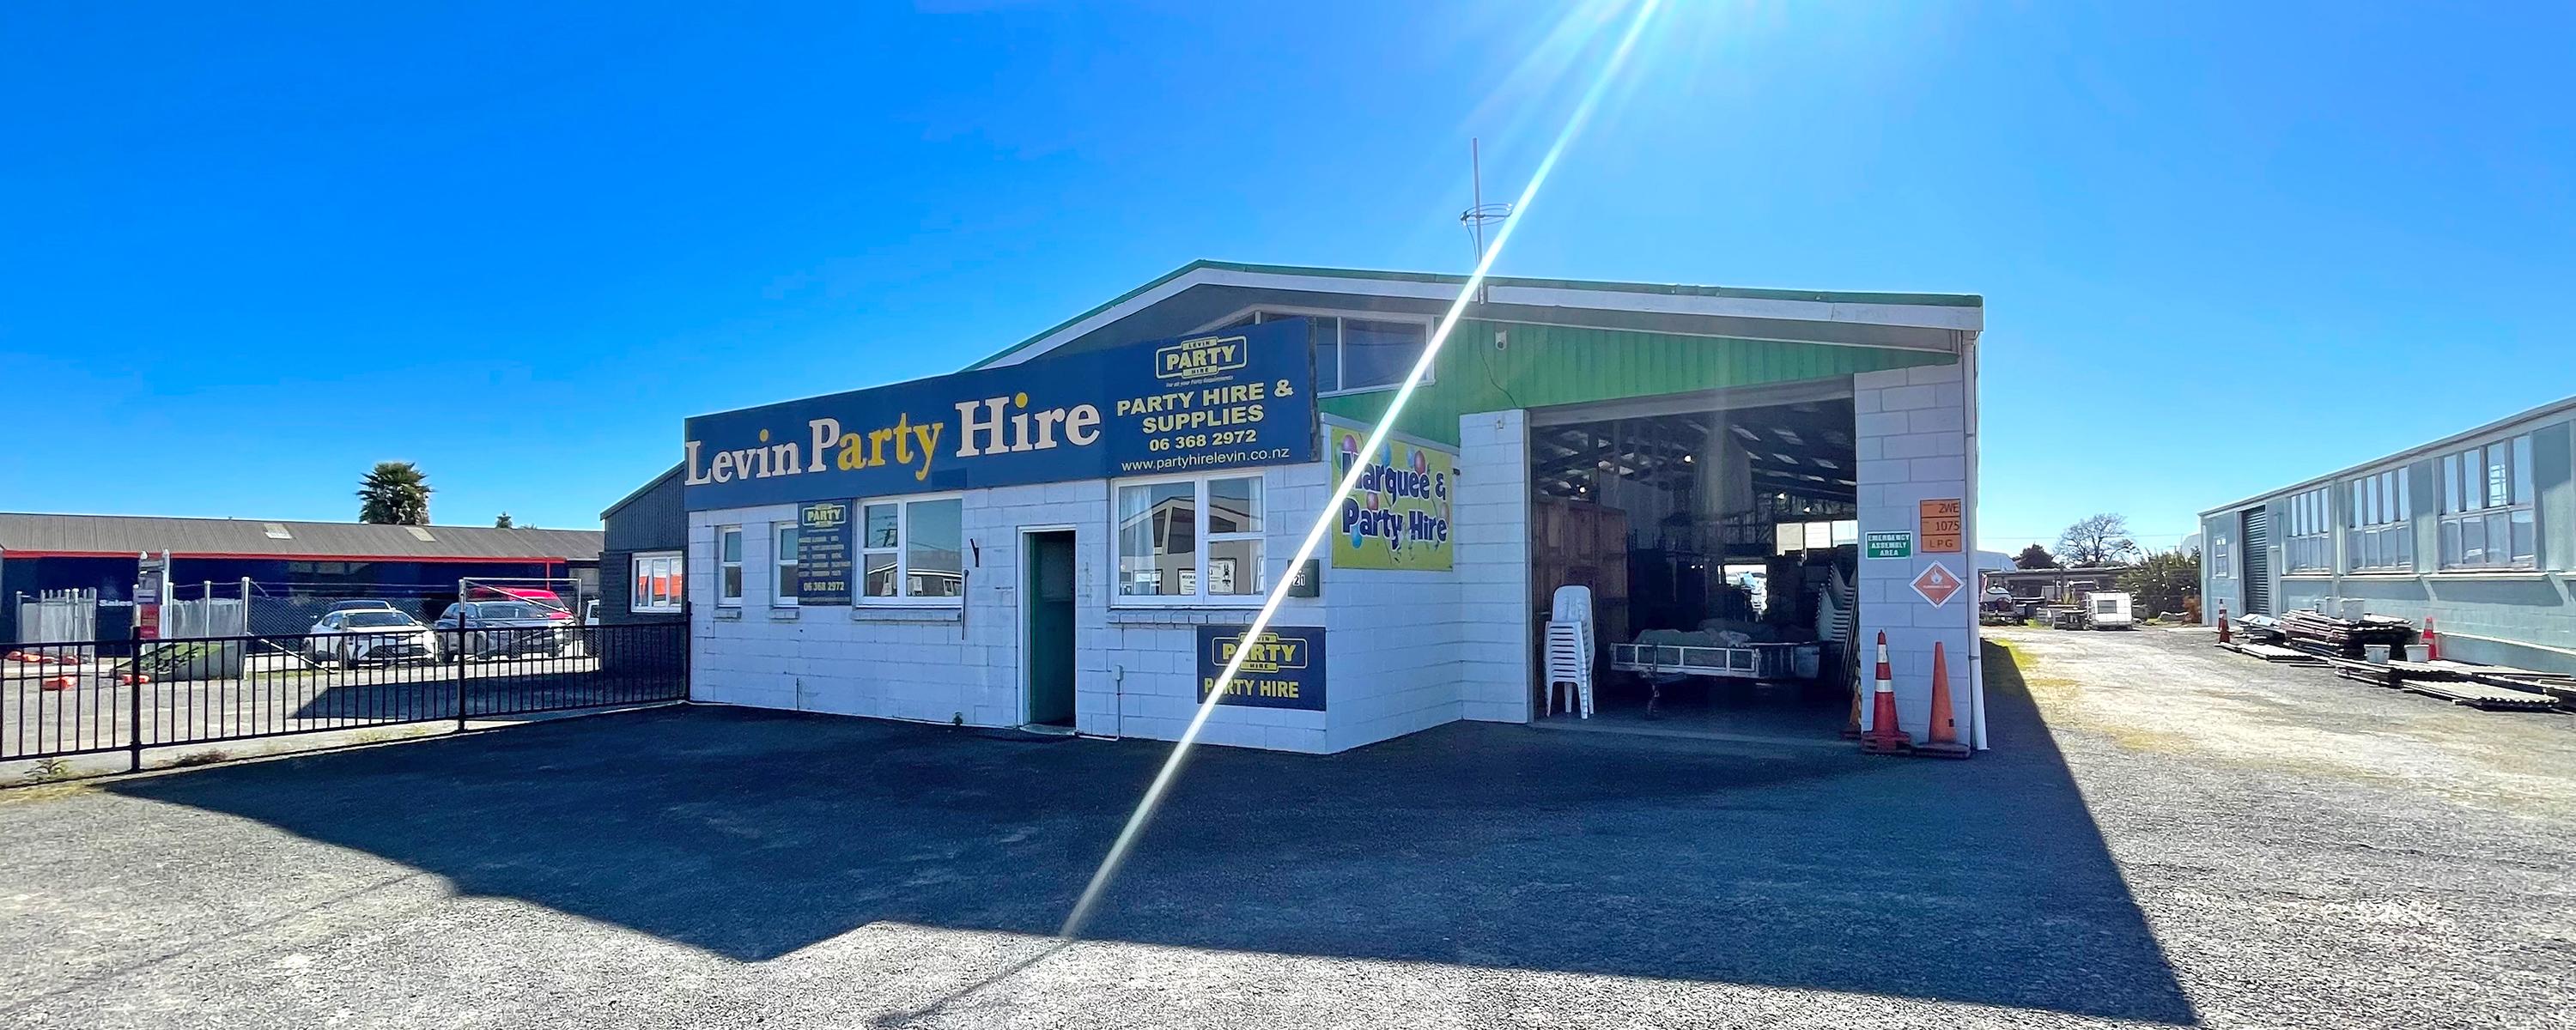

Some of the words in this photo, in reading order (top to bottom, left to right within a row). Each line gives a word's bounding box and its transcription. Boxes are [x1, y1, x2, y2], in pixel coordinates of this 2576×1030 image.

[1166, 344, 1236, 371] PARTY
[1117, 391, 1194, 416] PARTY
[1203, 383, 1264, 406] HIRE
[1274, 379, 1293, 397] &
[1142, 404, 1265, 434] SUPPLIES
[684, 428, 802, 486] Levin
[807, 412, 944, 482] Party
[955, 391, 1101, 458] Hire
[1149, 439, 1170, 451] 06
[1175, 434, 1206, 450] 368
[1212, 429, 1257, 446] 2972
[1121, 448, 1290, 471] www.partyhirelevin.co.nz
[1435, 472, 1447, 500] &
[807, 508, 841, 522] PARTY
[1342, 497, 1403, 551] Party
[1408, 510, 1449, 542] Hire
[1935, 520, 1959, 531] 1075
[1929, 539, 1953, 548] LPG
[803, 582, 812, 591] 06
[813, 582, 826, 591] 368
[827, 581, 845, 591] 2972
[1222, 643, 1297, 662] PRTY
[1204, 677, 1255, 696] PRTY
[1260, 680, 1299, 699] HIRE
